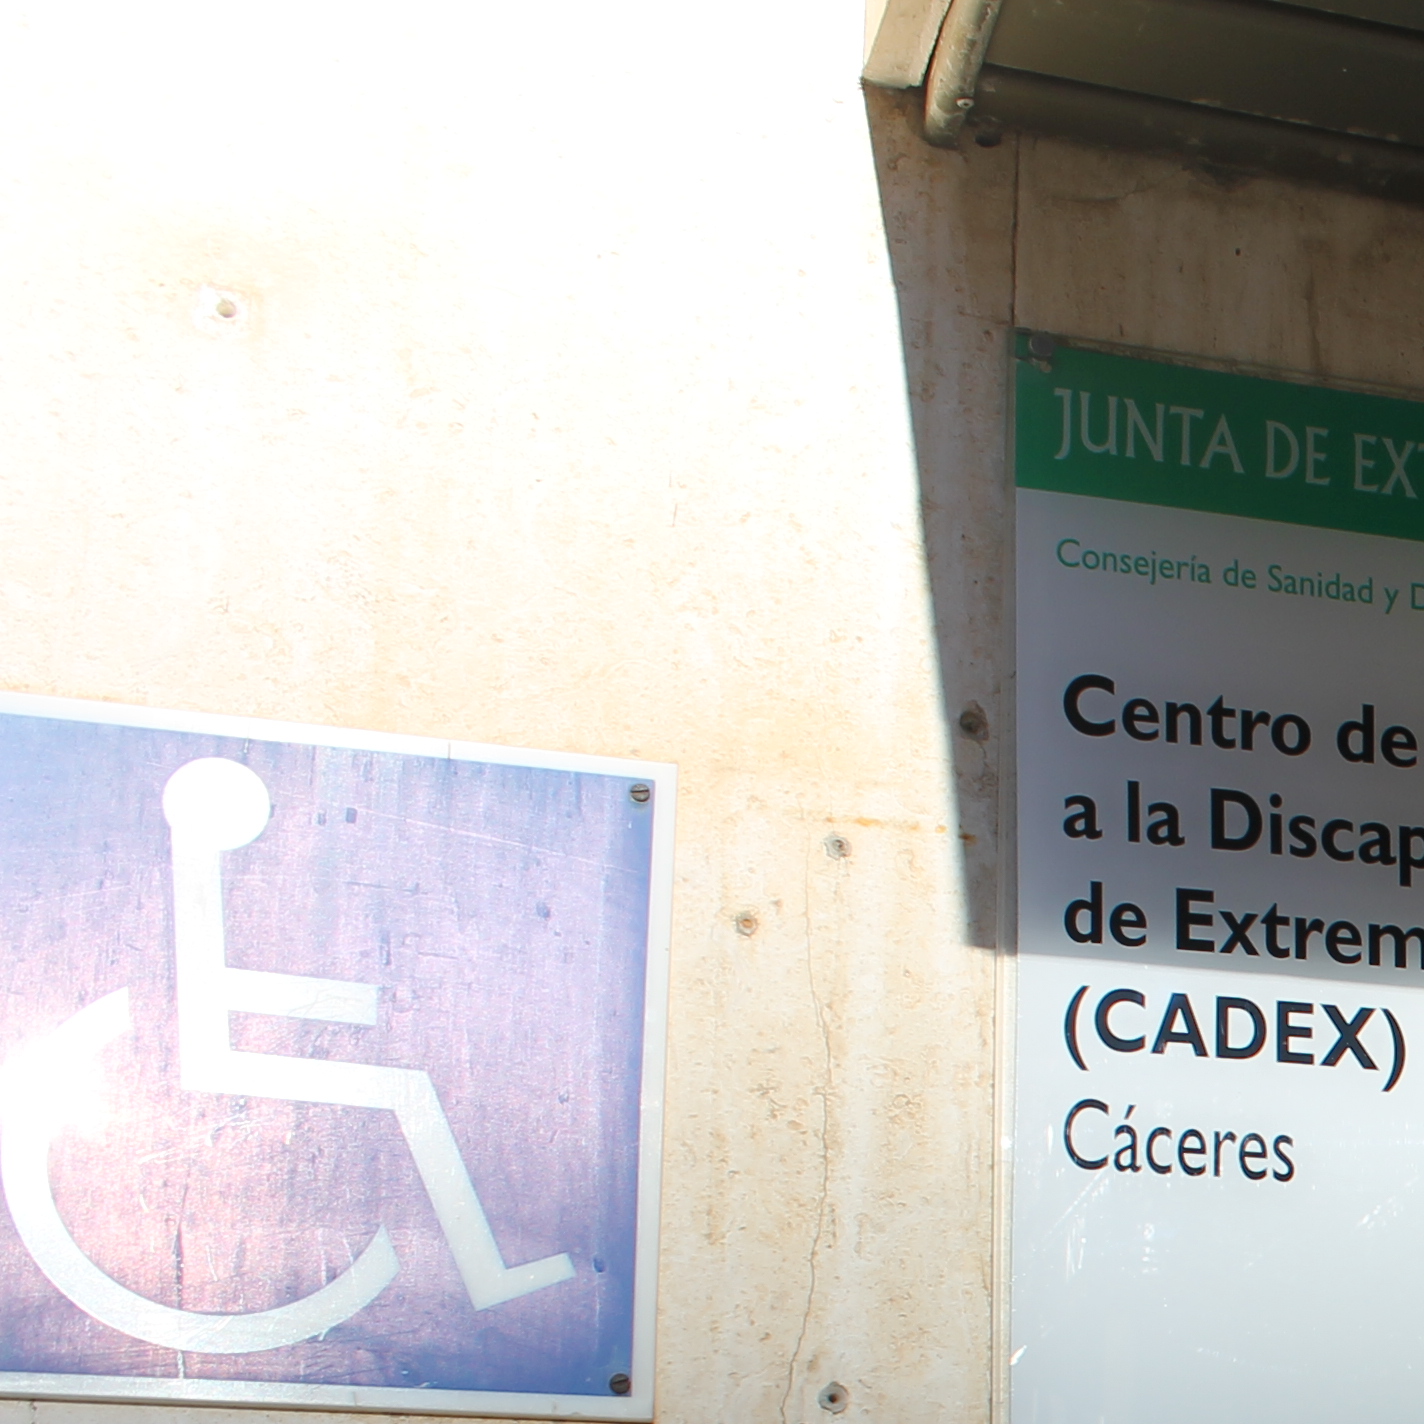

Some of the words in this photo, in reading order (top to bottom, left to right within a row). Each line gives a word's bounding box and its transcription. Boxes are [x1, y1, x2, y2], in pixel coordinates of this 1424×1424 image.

[1052, 386, 1245, 473] JUNTA
[1264, 419, 1331, 486] DE
[1055, 537, 1212, 586] Consejería
[1222, 558, 1257, 589] de
[1267, 563, 1374, 604] Sanidad
[1383, 587, 1400, 615] y
[1063, 674, 1312, 757] Centro
[1336, 703, 1418, 768] de
[1063, 795, 1103, 840] a
[1127, 780, 1186, 847] la
[1064, 880, 1147, 947] de
[1063, 985, 1406, 1093] (CADEX)
[1063, 1098, 1295, 1183] Cáceres
